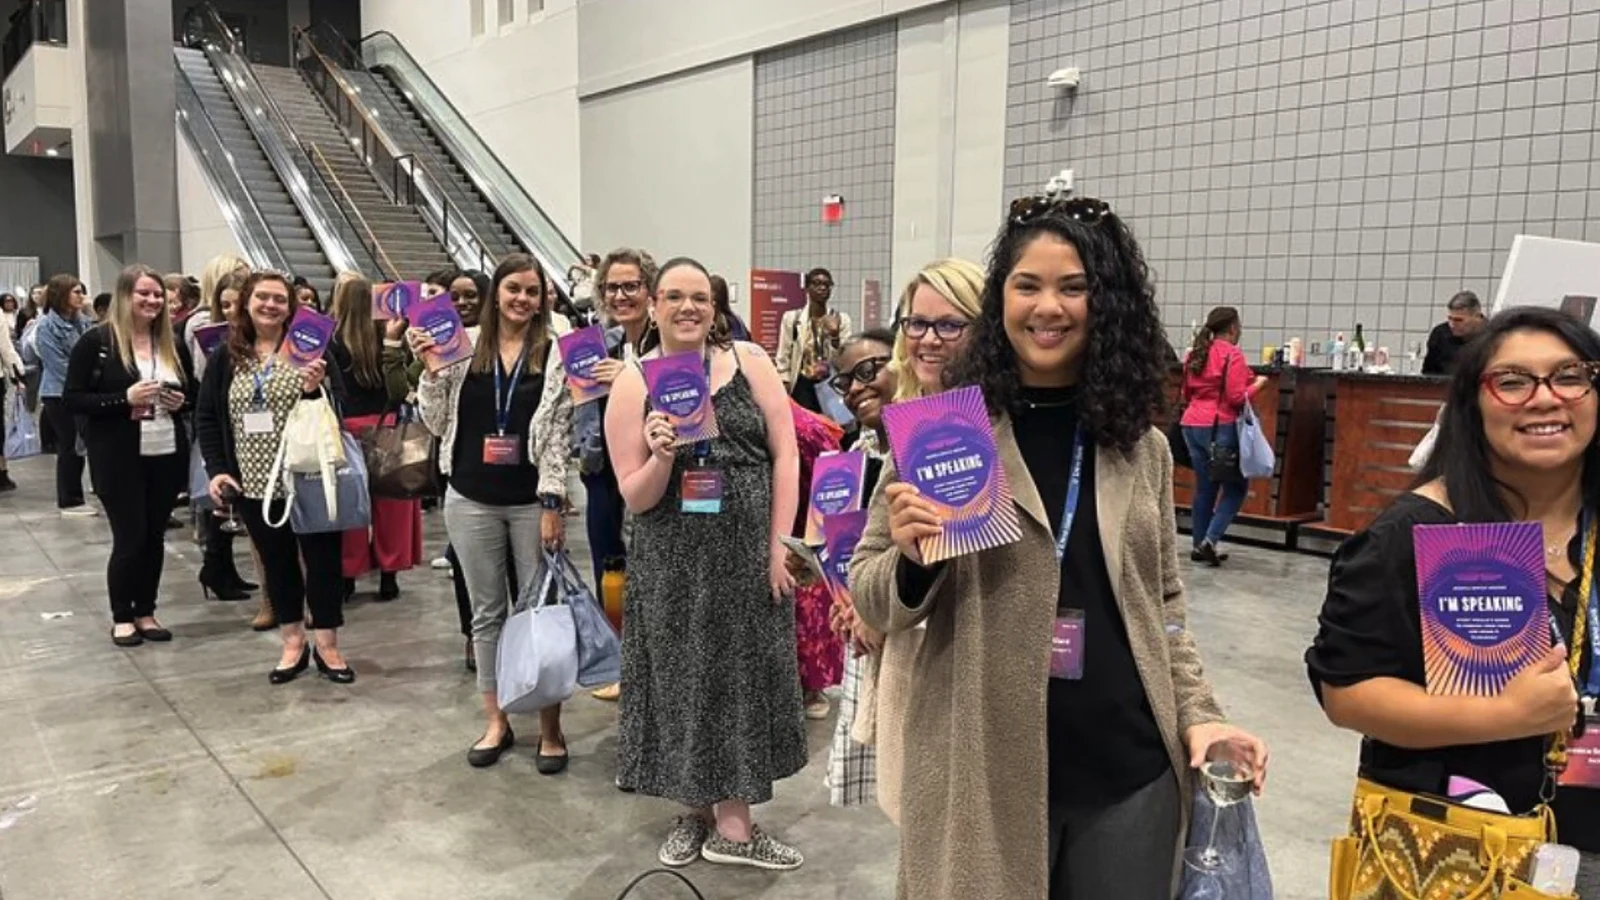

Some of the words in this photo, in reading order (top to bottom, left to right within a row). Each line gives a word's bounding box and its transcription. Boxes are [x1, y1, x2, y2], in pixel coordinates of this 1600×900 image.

[916, 465, 935, 482] I'M
[935, 453, 984, 477] SPEAKING
[1438, 596, 1459, 612] I'M
[1461, 596, 1524, 612] SPEAKING
